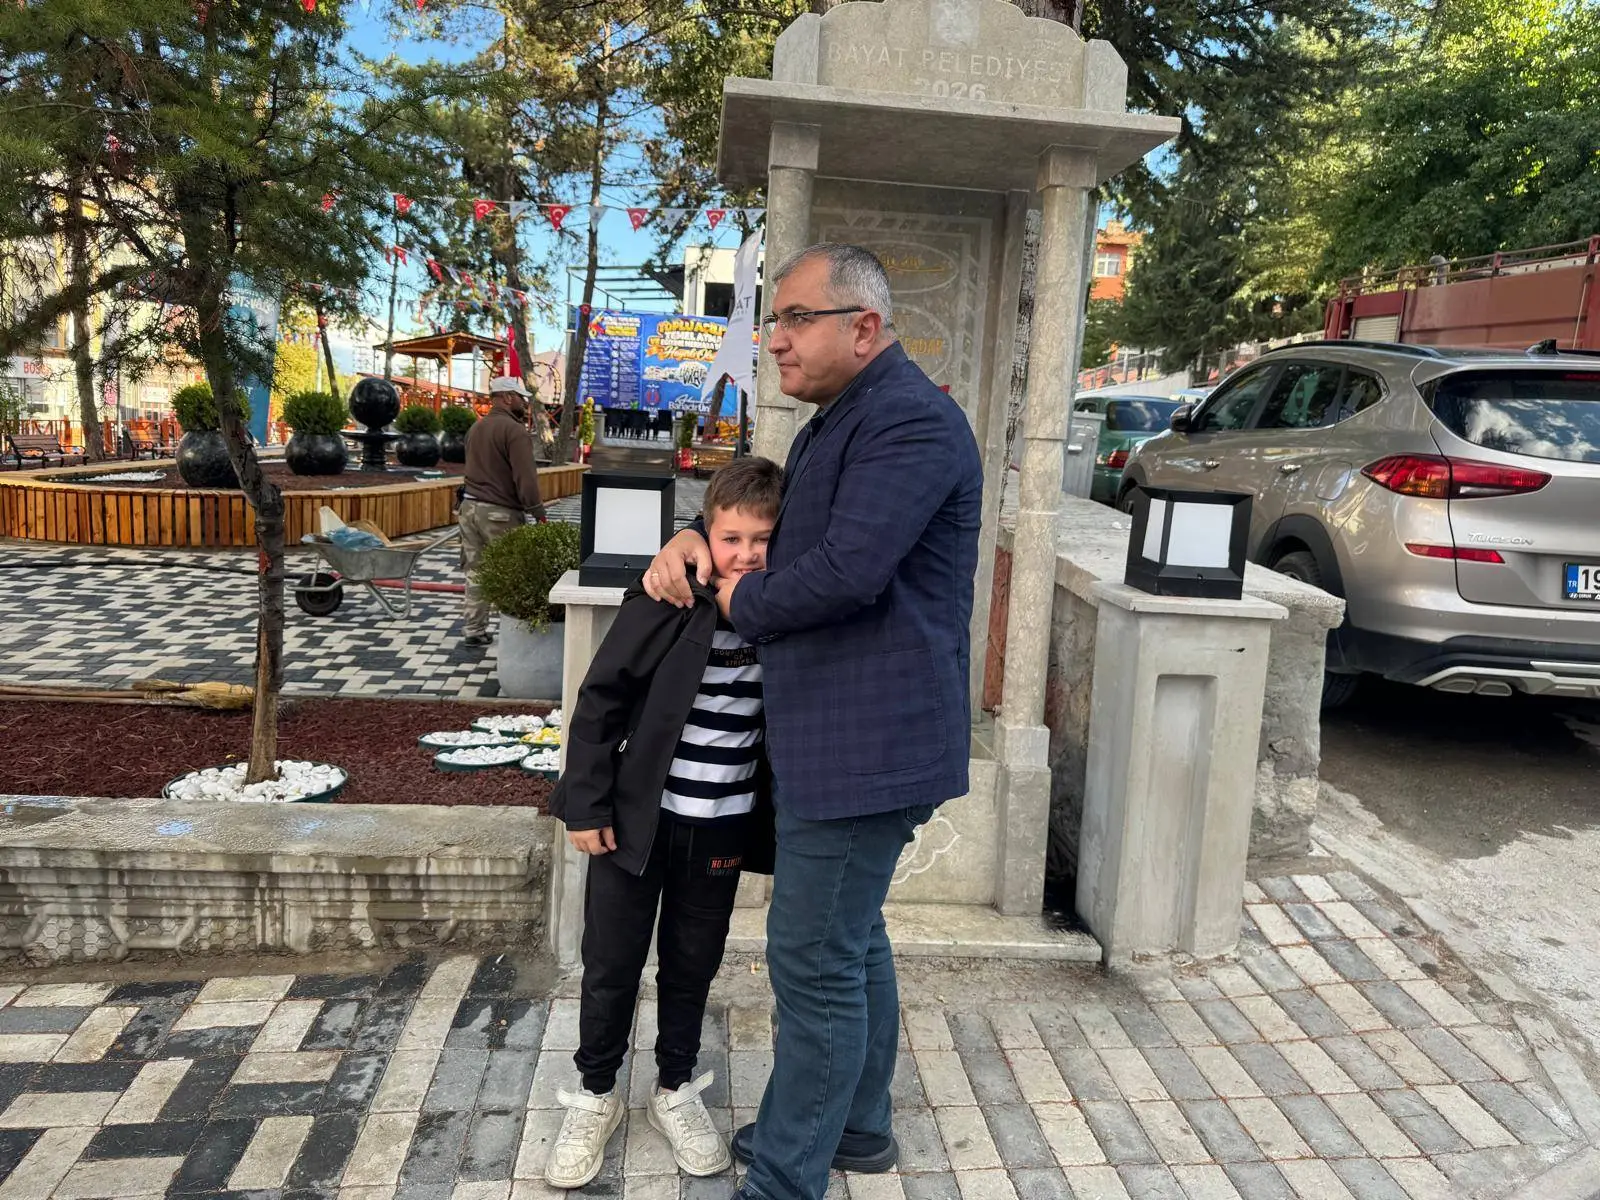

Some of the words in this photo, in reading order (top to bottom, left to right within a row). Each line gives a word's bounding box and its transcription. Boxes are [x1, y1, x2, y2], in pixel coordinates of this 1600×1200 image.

[828, 41, 911, 69] BAYAT
[1468, 533, 1534, 545] TUCSON
[1568, 580, 1577, 588] TR
[711, 859, 722, 869] NO
